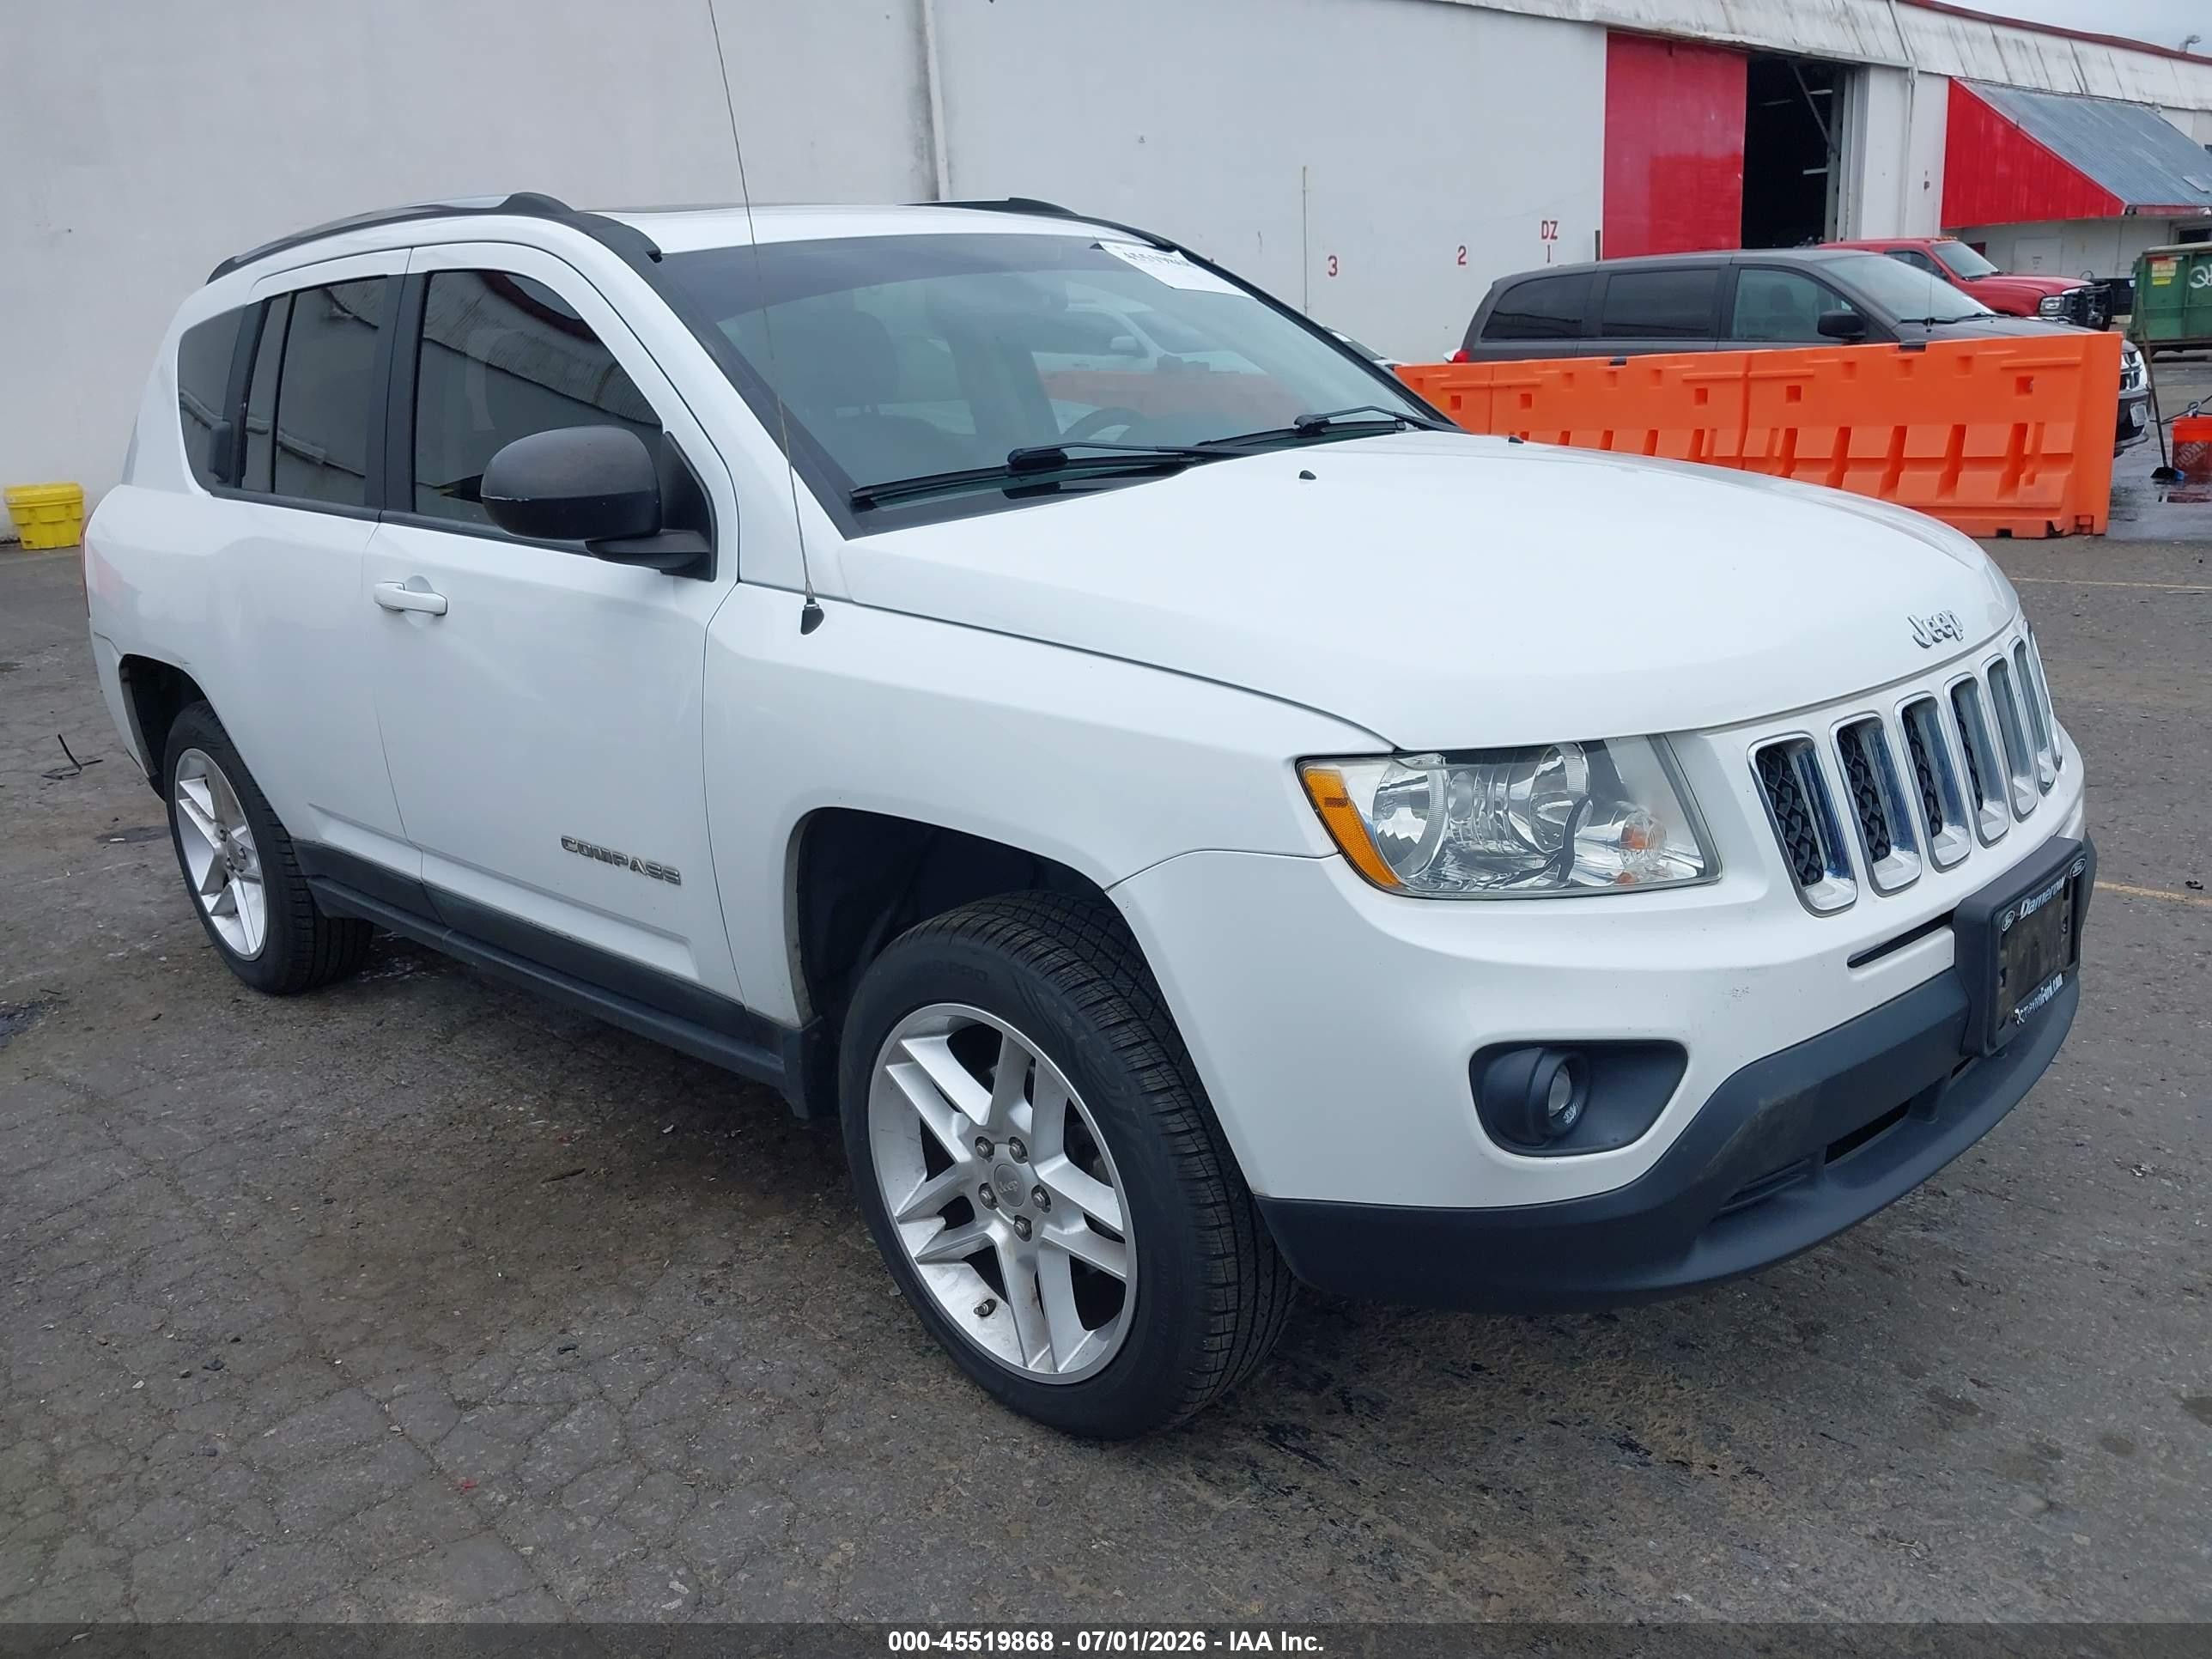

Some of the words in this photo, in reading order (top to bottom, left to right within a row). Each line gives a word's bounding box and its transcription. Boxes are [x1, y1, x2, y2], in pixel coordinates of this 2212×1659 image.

[1541, 220, 1559, 241] DZ
[1328, 255, 1338, 277] 3
[1457, 245, 1467, 266] 2
[1907, 611, 1965, 649] Jeep
[561, 836, 682, 886] COMPASS
